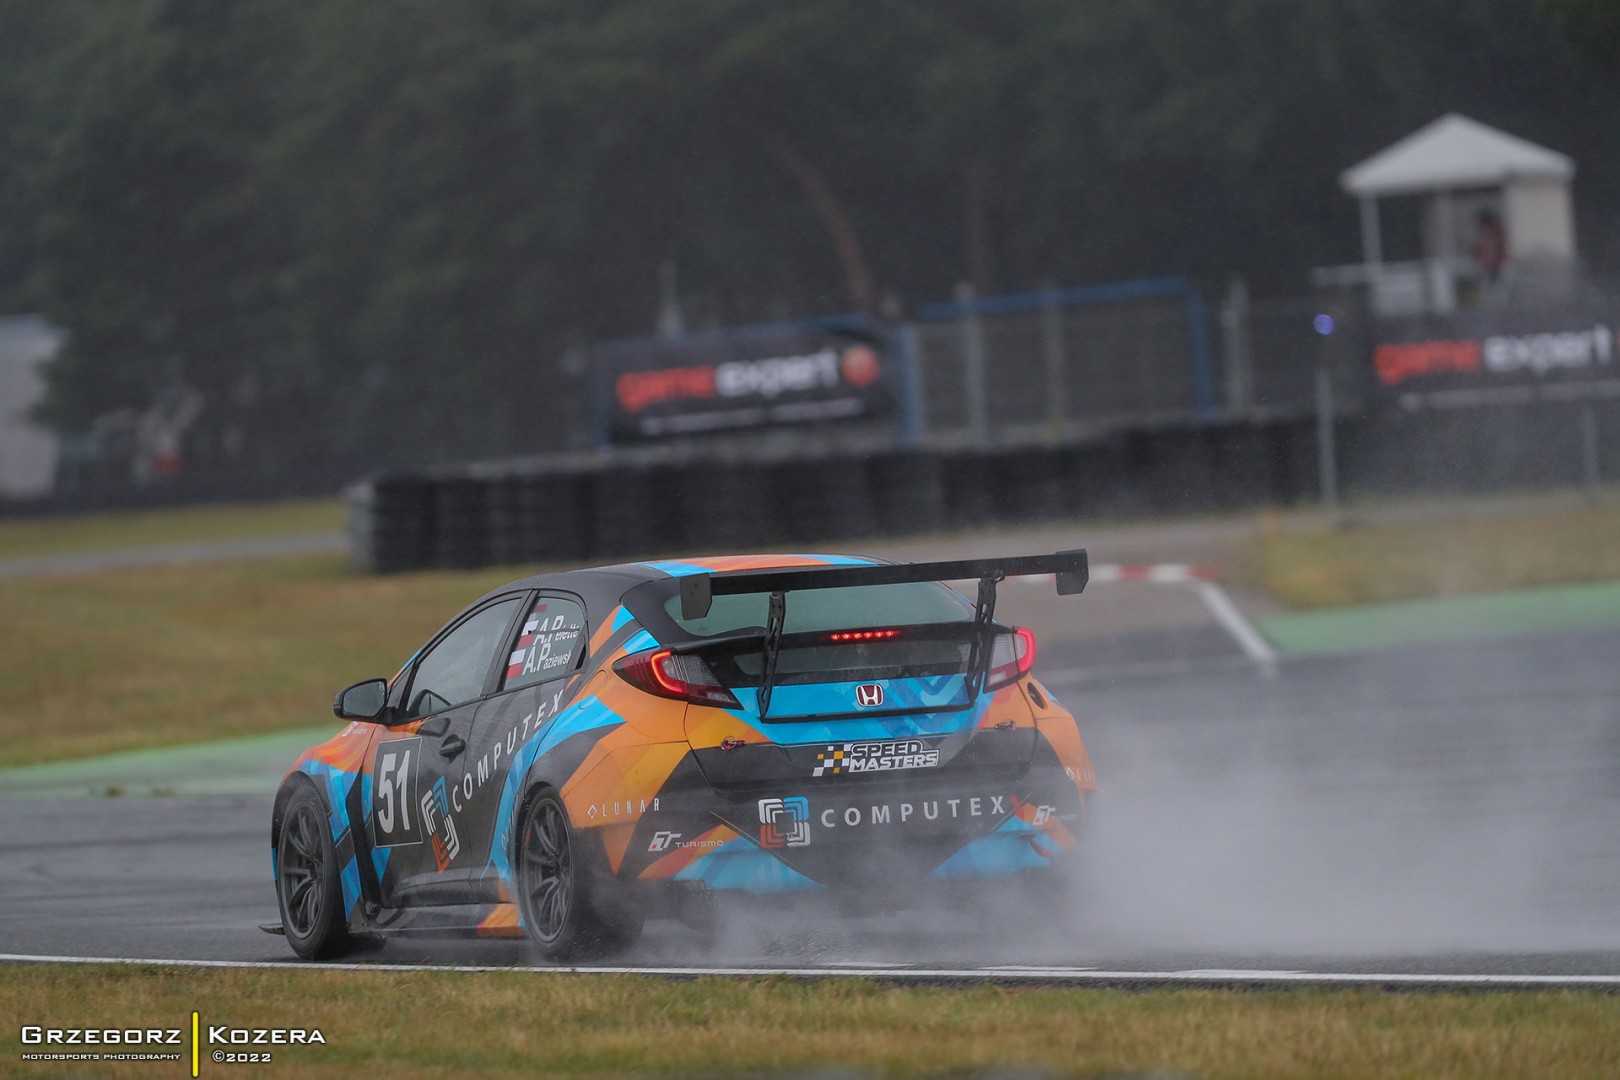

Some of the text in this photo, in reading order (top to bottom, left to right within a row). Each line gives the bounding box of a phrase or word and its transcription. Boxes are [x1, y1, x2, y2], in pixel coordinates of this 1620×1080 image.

[453, 689, 565, 812] COMPUTEX
[850, 751, 938, 771] MASTERS
[851, 741, 922, 757] SPEED
[378, 750, 411, 834] 51
[602, 797, 660, 817] LUNAR
[821, 795, 1005, 828] COMPUTEX
